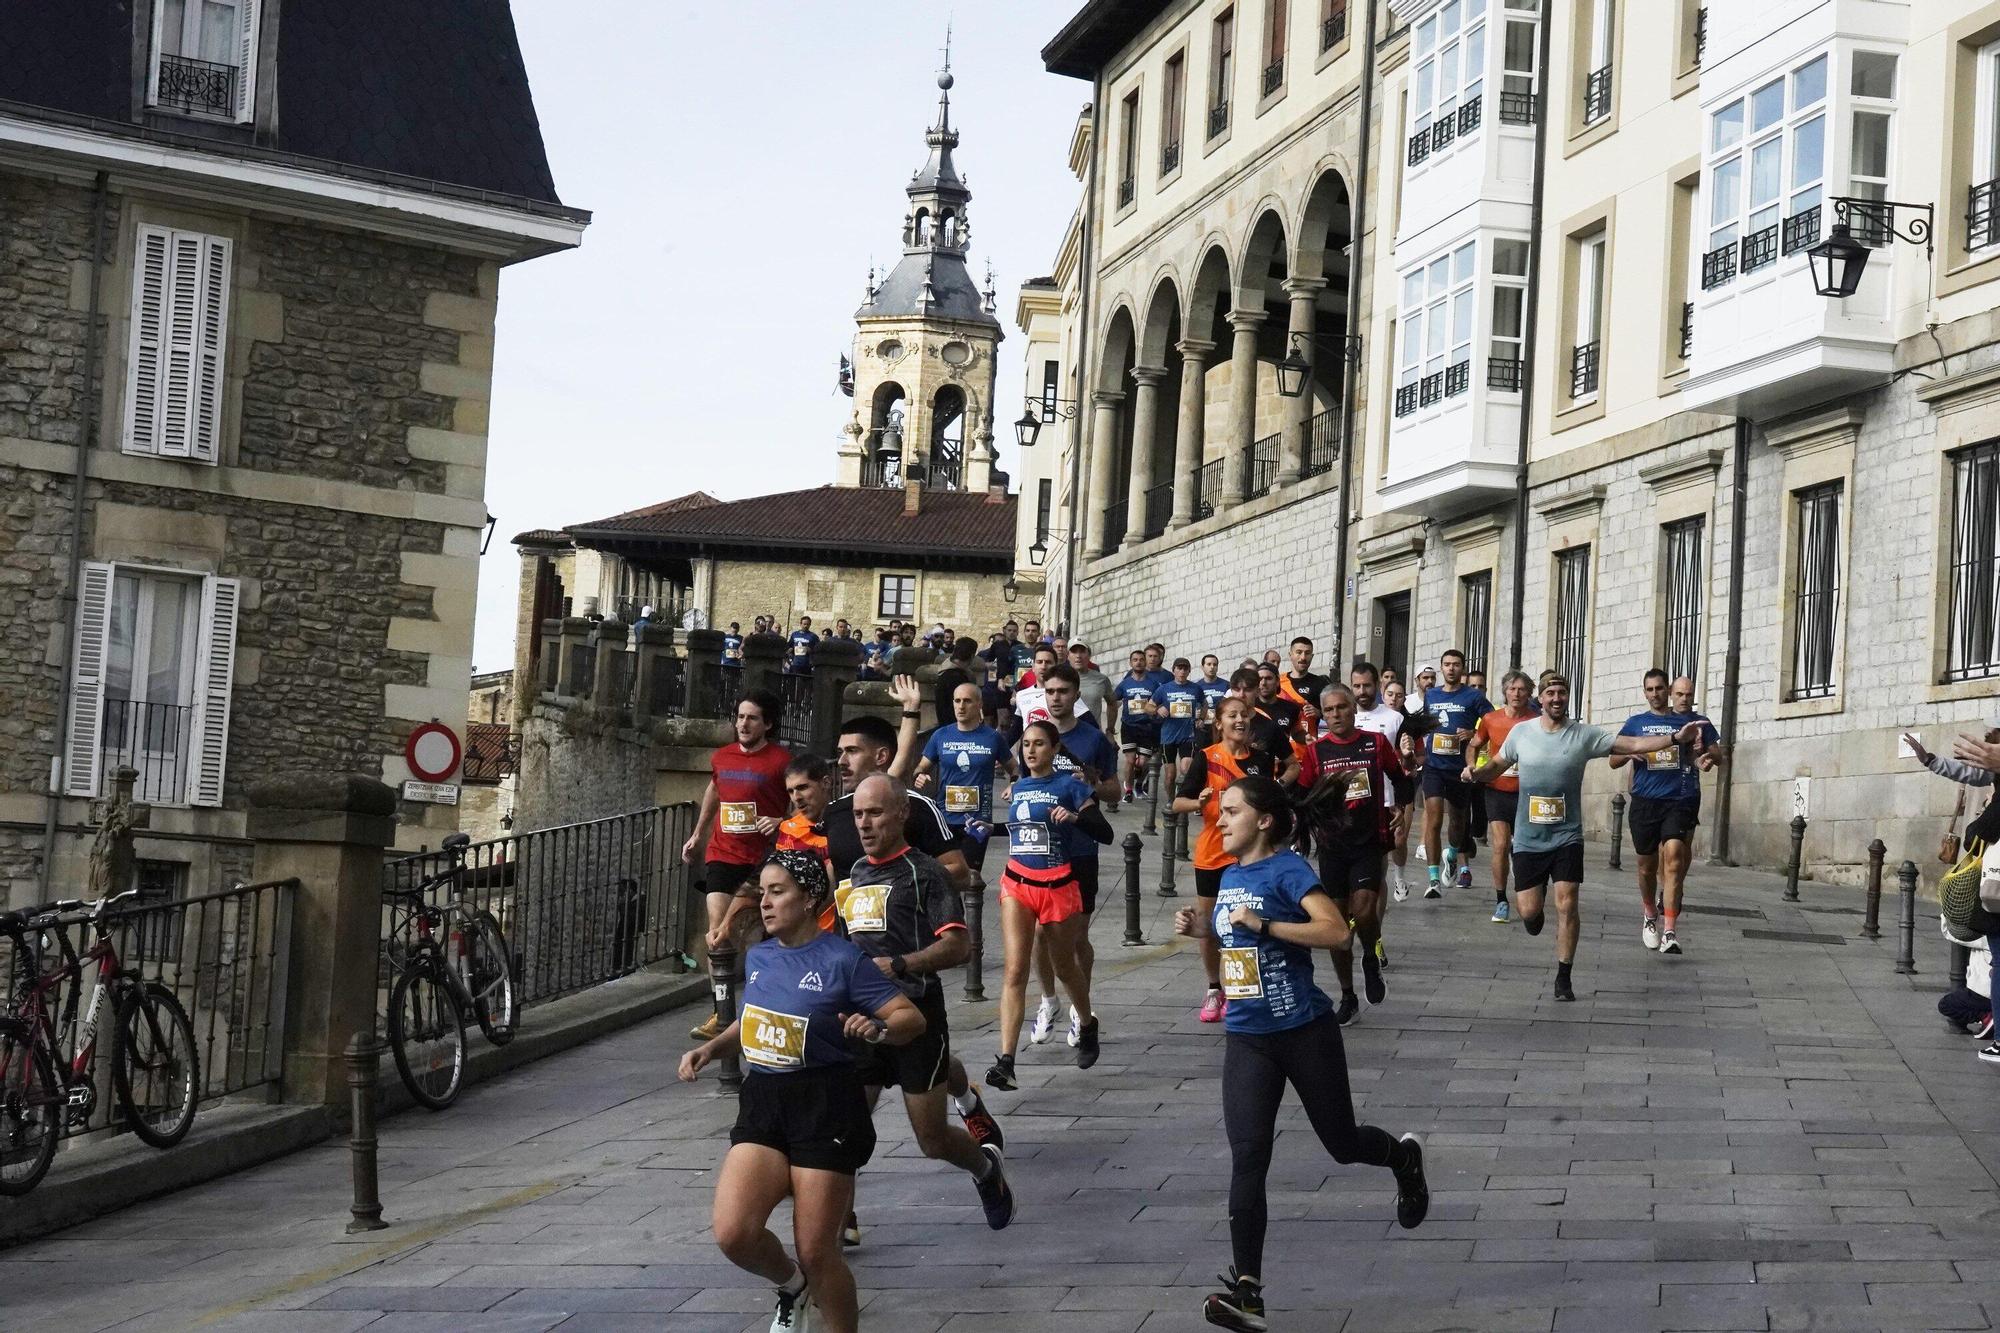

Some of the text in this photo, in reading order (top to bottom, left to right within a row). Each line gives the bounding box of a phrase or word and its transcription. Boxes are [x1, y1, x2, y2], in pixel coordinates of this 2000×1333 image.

[1538, 803, 1556, 814] 564
[728, 810, 745, 822] 375
[1019, 829, 1038, 842] 926
[852, 896, 875, 914] 664
[1225, 960, 1245, 980] 663
[798, 983, 823, 992] MADEN
[755, 1023, 786, 1048] 443
